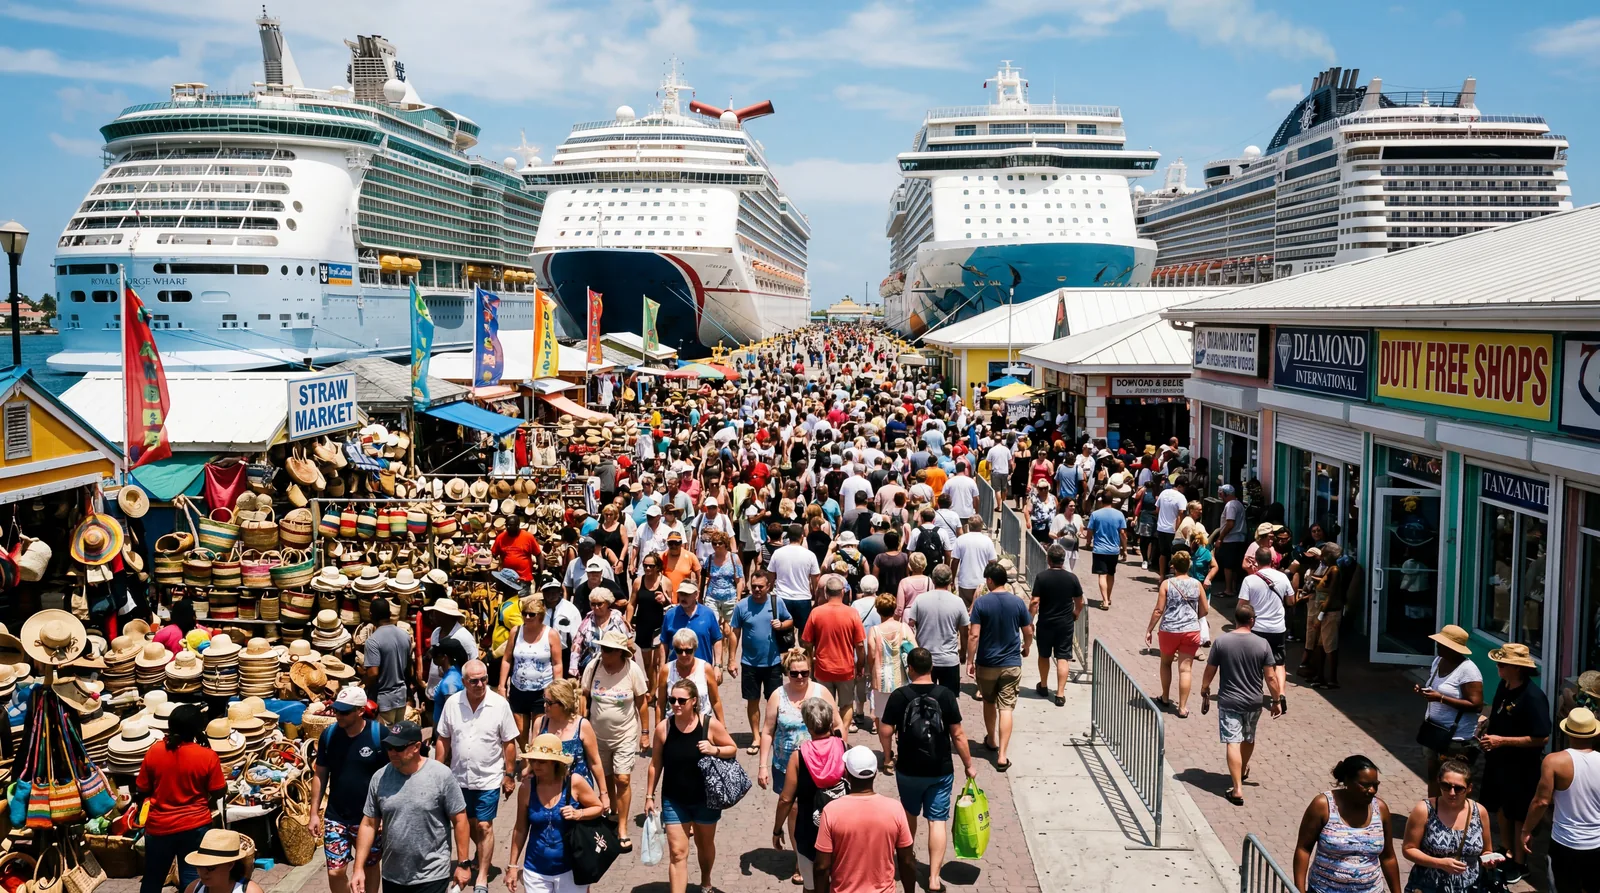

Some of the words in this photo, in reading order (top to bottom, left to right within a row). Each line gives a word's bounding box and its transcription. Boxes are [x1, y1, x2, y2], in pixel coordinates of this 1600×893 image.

[91, 278, 115, 286] ROYAL
[154, 277, 188, 286] WHARF
[1293, 333, 1366, 366] DIAMOND
[1295, 369, 1357, 391] INTERNATIONAL
[1379, 340, 1423, 390] DUTY
[1425, 342, 1470, 396] FREE
[1473, 343, 1549, 407] SHOPS
[299, 378, 348, 406] STRAW
[295, 401, 354, 433] MARKET
